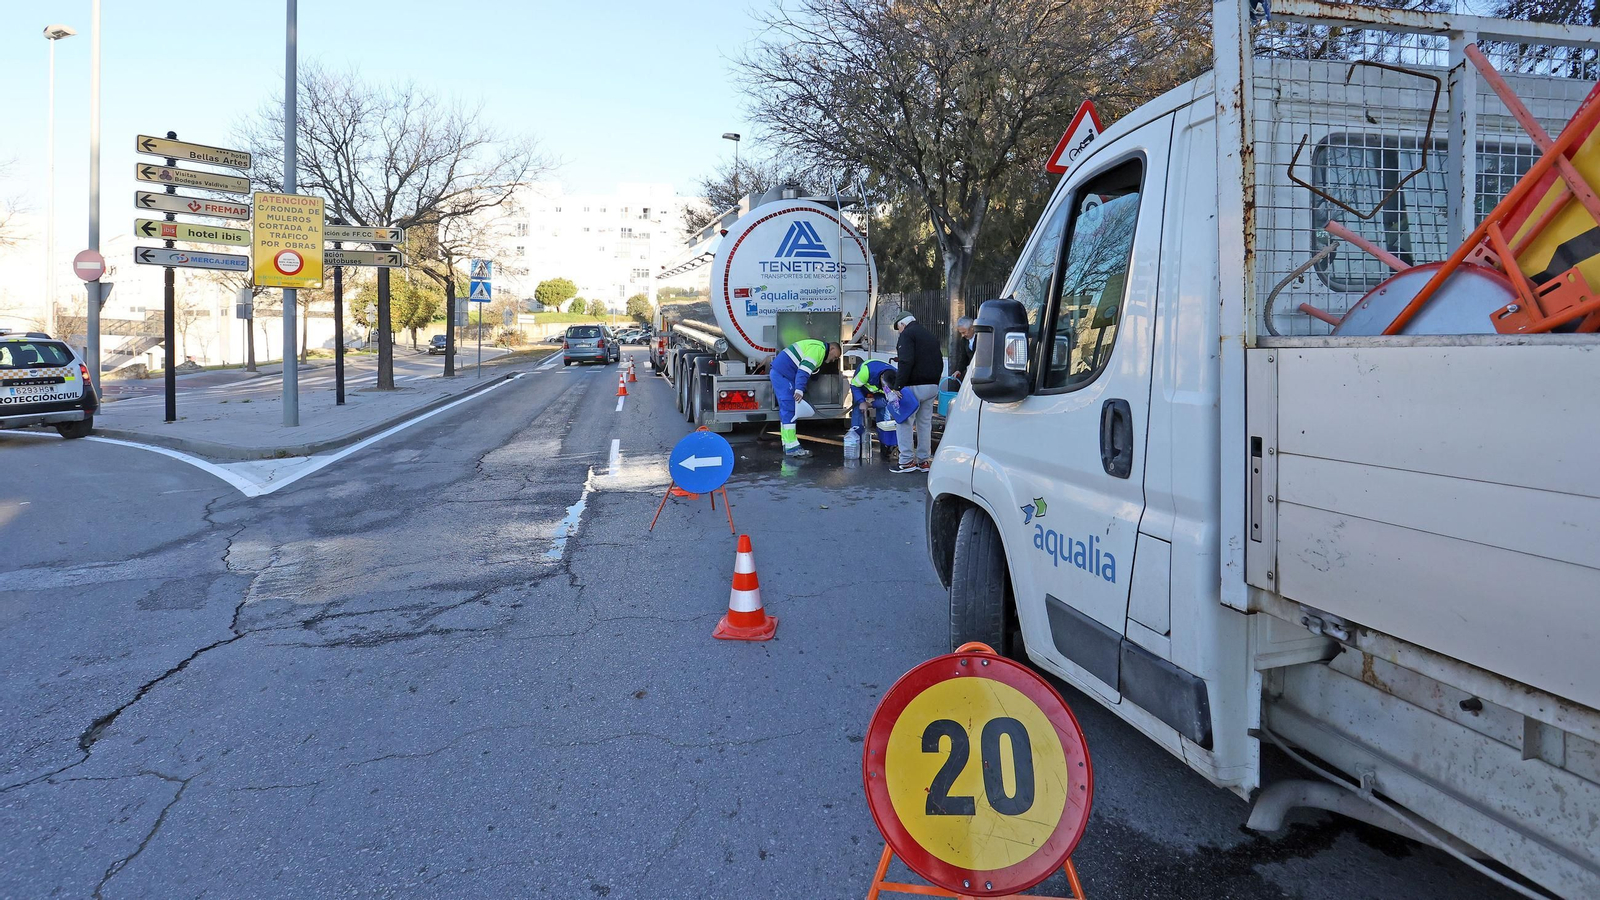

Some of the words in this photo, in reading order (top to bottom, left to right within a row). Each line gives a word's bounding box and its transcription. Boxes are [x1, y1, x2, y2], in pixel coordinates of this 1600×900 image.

[190, 151, 219, 162] Bellas
[223, 157, 248, 167] Artes
[175, 177, 202, 185] Bodegas
[205, 204, 247, 215] FREMAP
[258, 205, 303, 214] C/RONDA
[267, 214, 311, 223] MULEROS
[163, 225, 175, 233] ibis
[259, 223, 302, 231] CORTADA
[188, 229, 217, 239] hotel
[222, 232, 241, 241] ibis
[270, 232, 308, 240] TRÁFICO
[190, 256, 246, 266] MERCAJEREZ
[800, 287, 832, 295] aquajerez
[760, 290, 799, 302] aqualia
[1033, 523, 1116, 584] aqualia
[921, 717, 1035, 815] 20
